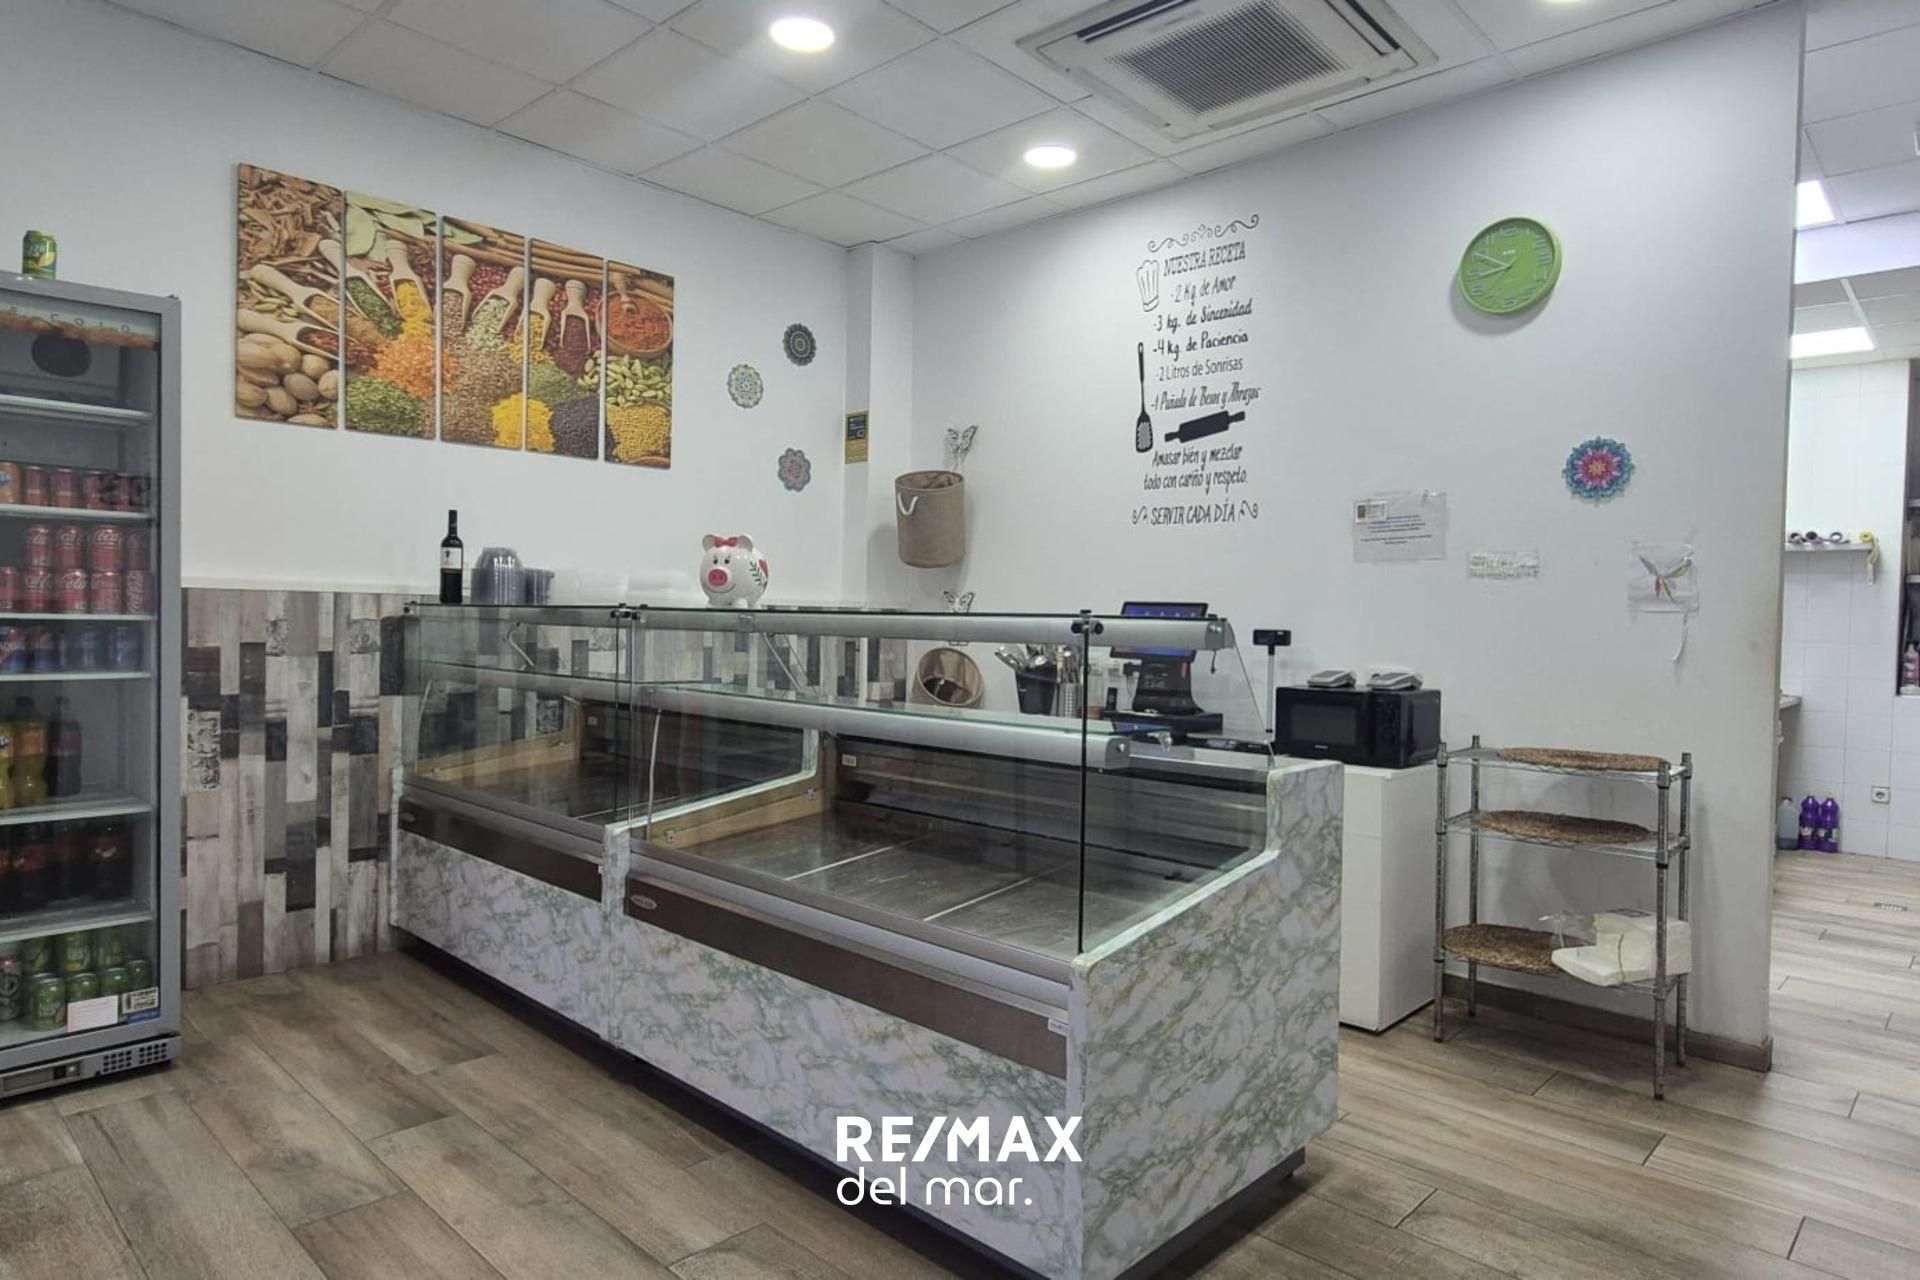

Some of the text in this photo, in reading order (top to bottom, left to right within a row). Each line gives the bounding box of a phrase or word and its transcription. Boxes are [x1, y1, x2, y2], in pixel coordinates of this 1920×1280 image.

[1163, 240, 1246, 276] NUESTRA RECETA
[1200, 279, 1210, 297] de
[1211, 275, 1236, 295] Amor
[1186, 310, 1197, 326] de
[1200, 298, 1253, 323] Sinceridad
[1186, 336, 1197, 351] de
[1201, 329, 1249, 349] Paciencia
[1166, 364, 1190, 380] Litros
[1191, 360, 1203, 376] de
[1205, 357, 1243, 375] Sonrisas
[1188, 387, 1197, 407] de
[1220, 392, 1227, 410] y
[1152, 443, 1243, 472] Amasar bien y mezclar
[1143, 466, 1248, 495] todo con cariño y respeto
[1150, 498, 1235, 525] SERVIR CADA DÍA
